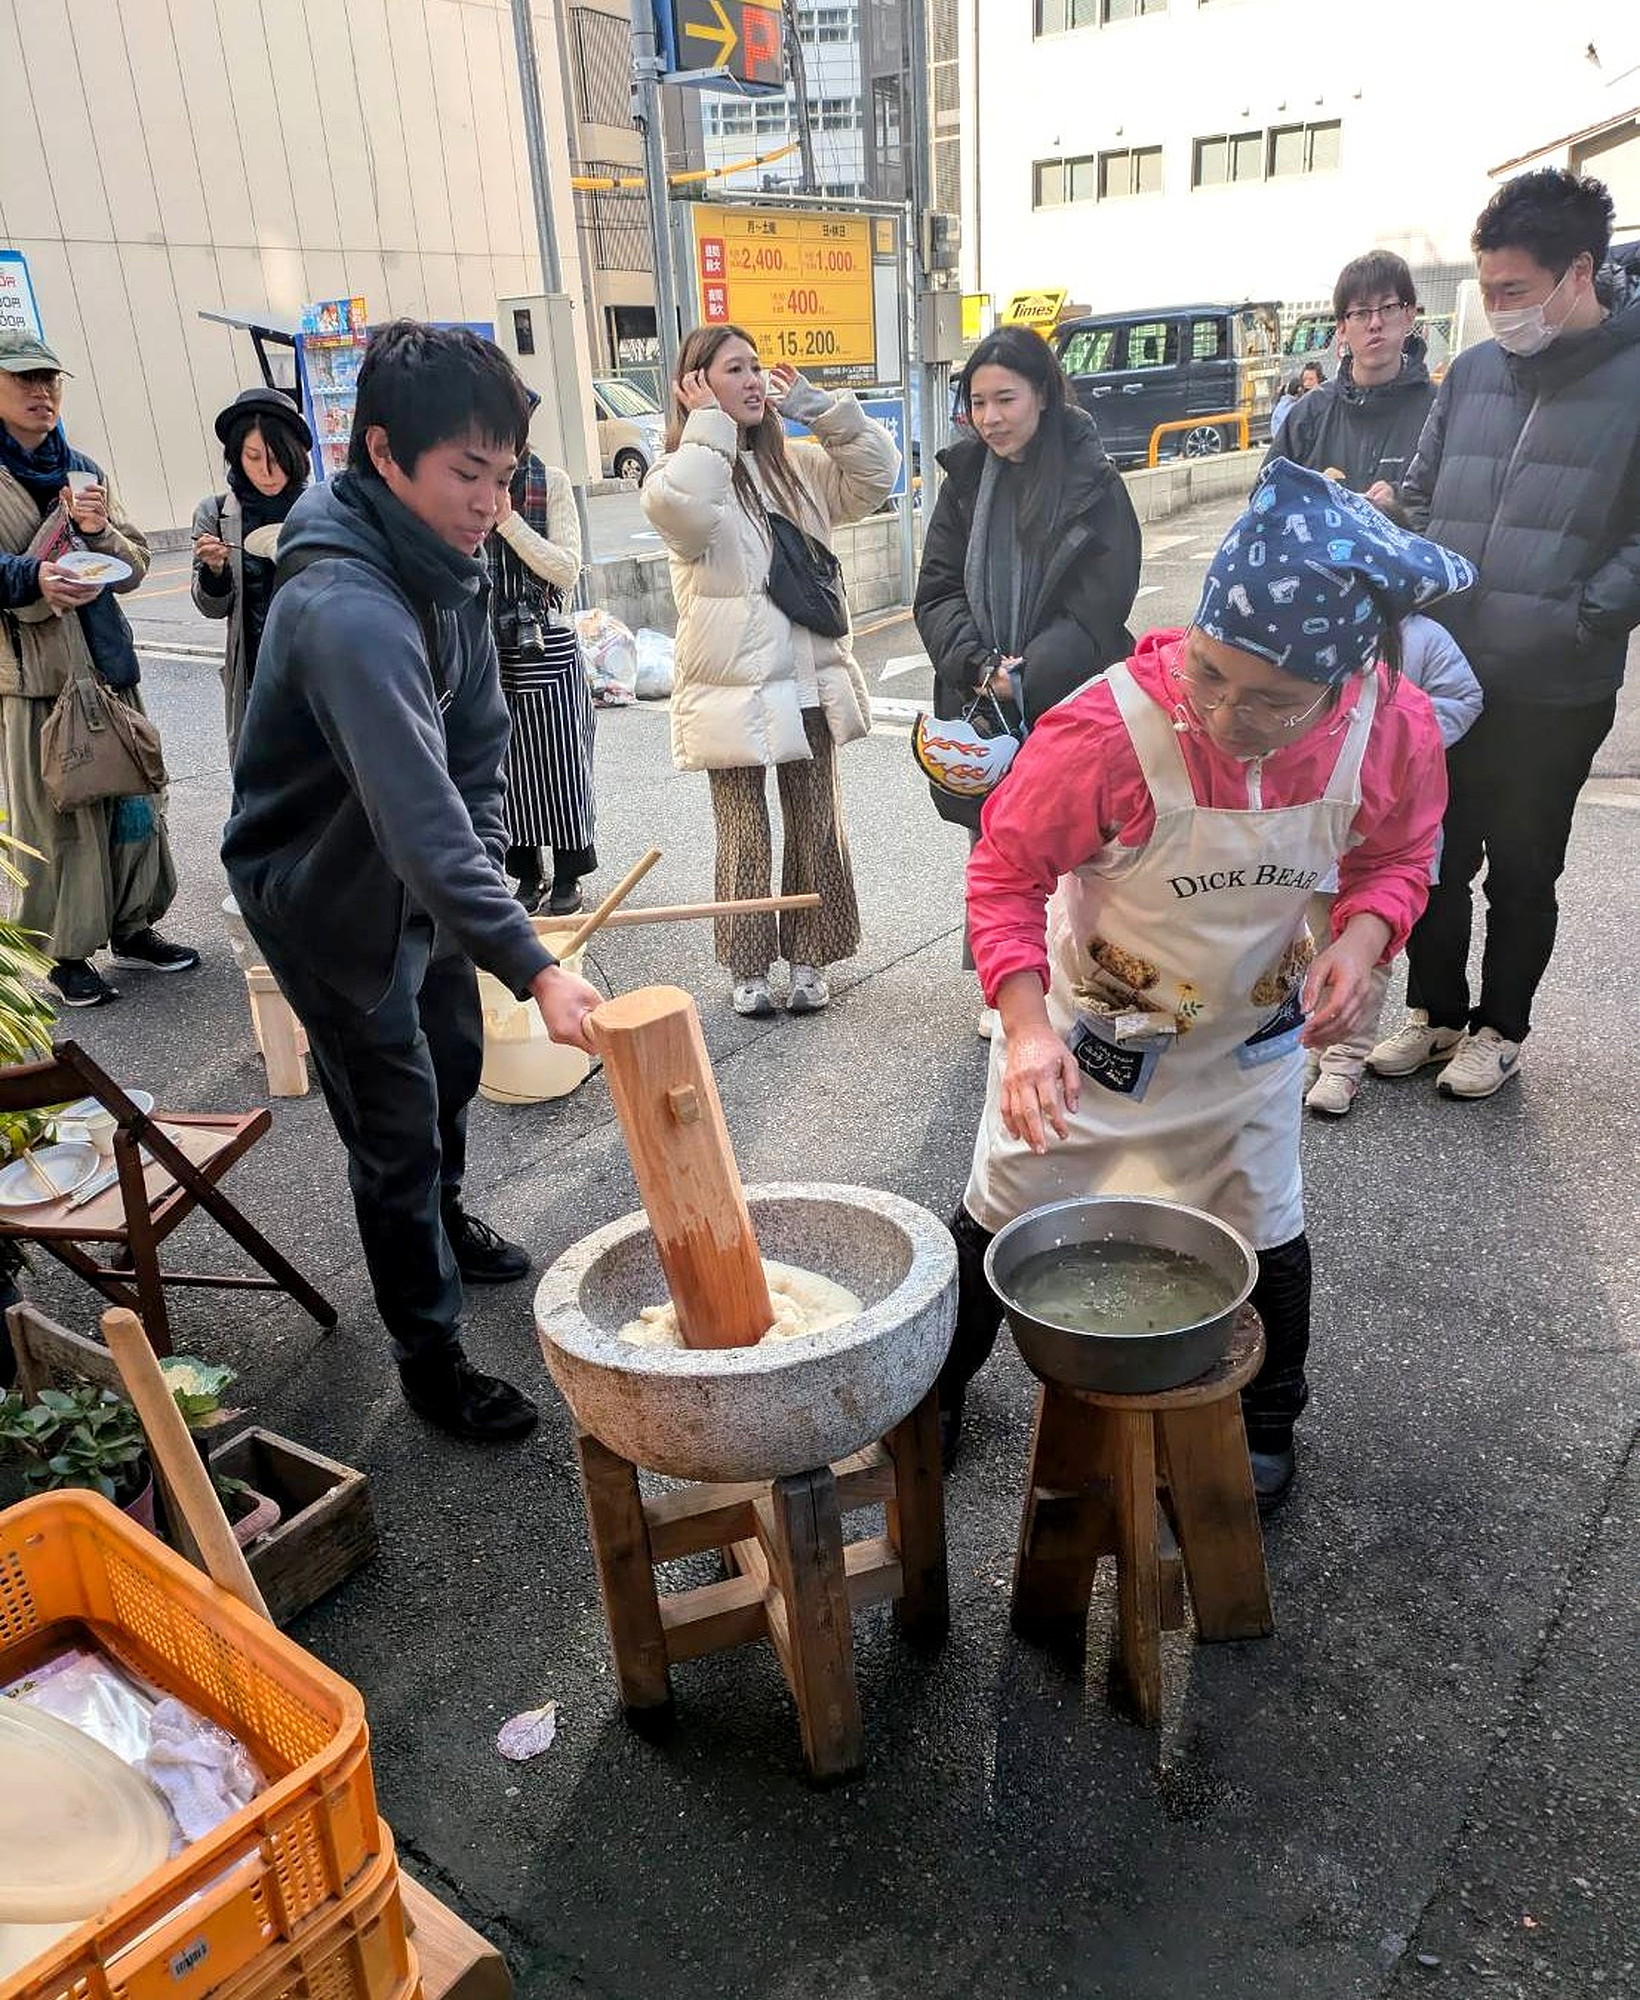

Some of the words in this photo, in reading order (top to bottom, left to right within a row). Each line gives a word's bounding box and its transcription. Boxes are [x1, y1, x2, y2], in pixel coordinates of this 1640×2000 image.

[742, 5, 777, 81] P
[1013, 302, 1055, 319] Times
[1166, 869, 1246, 898] DICK
